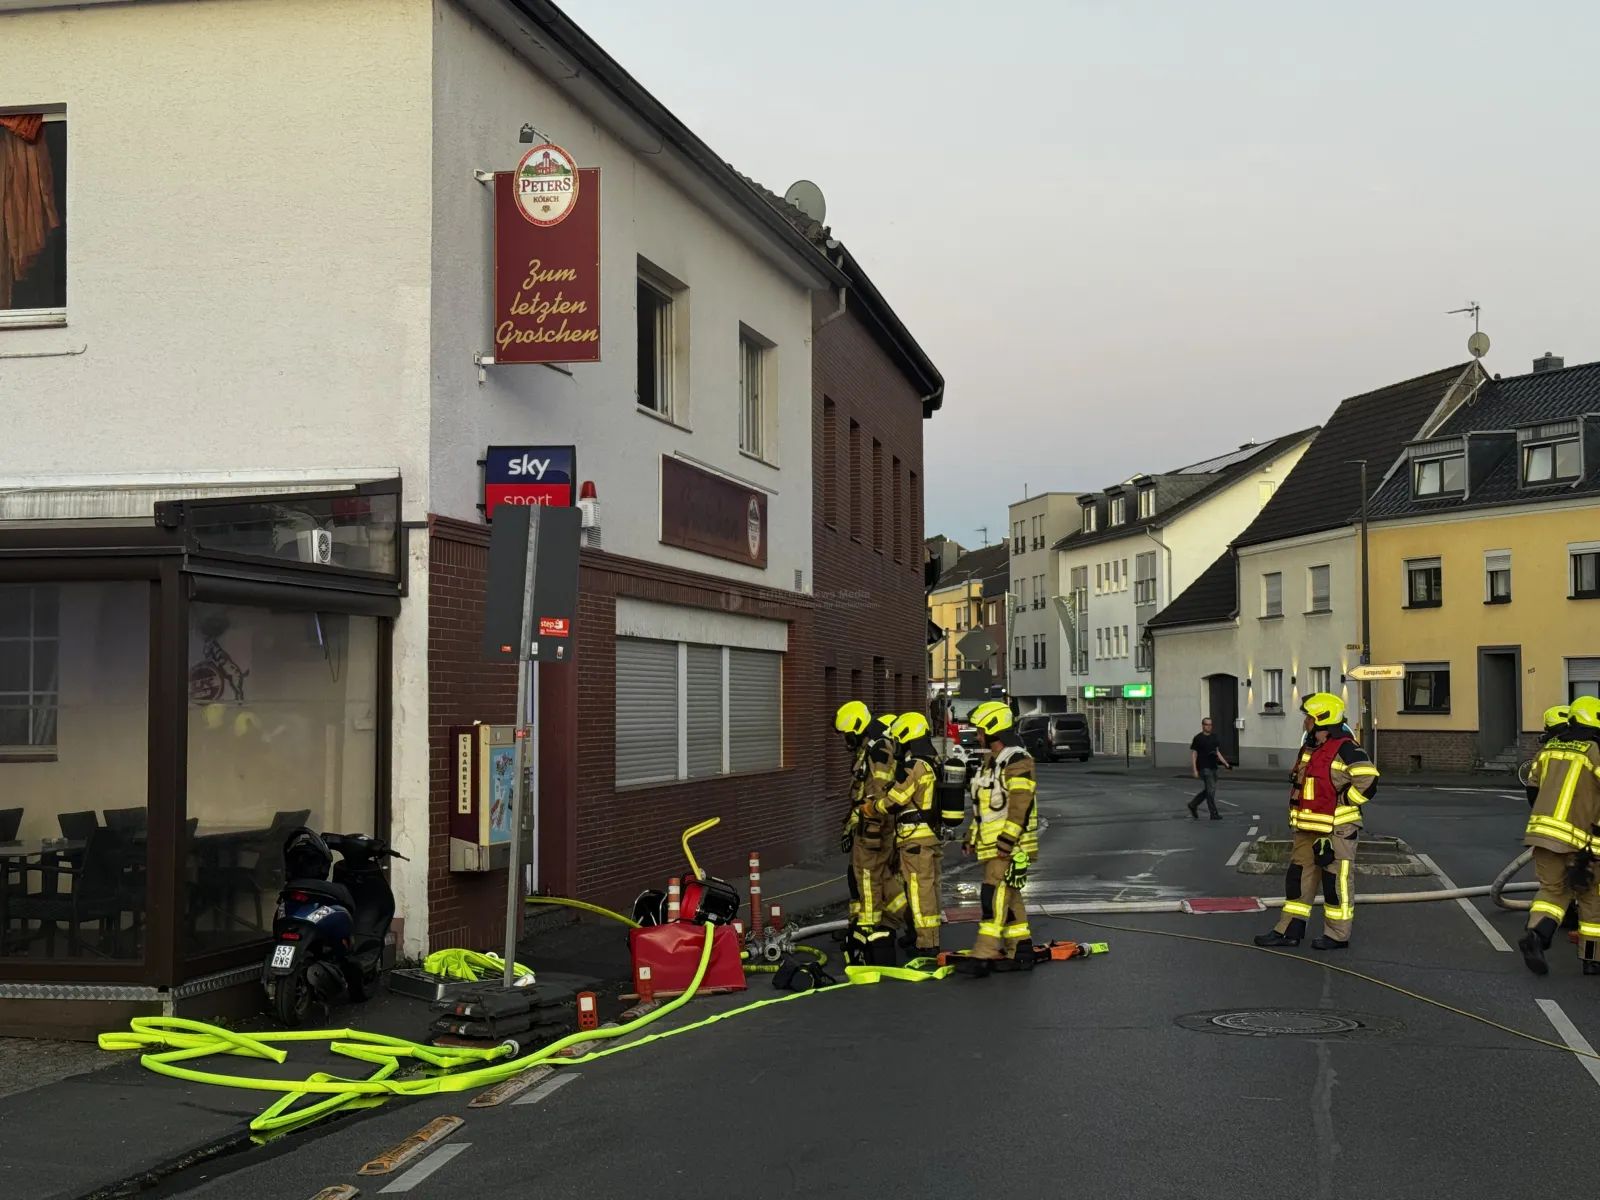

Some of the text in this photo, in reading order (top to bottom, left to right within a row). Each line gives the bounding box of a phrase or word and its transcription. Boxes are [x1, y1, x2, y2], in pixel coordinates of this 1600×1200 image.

[521, 177, 571, 192] PETERS
[533, 195, 559, 203] KÖLSCH
[522, 259, 577, 290] Zum
[510, 291, 587, 324] letzten
[496, 318, 599, 351] Groschen
[508, 453, 551, 480] sky
[274, 957, 290, 966] RNS
[276, 946, 292, 956] 557
